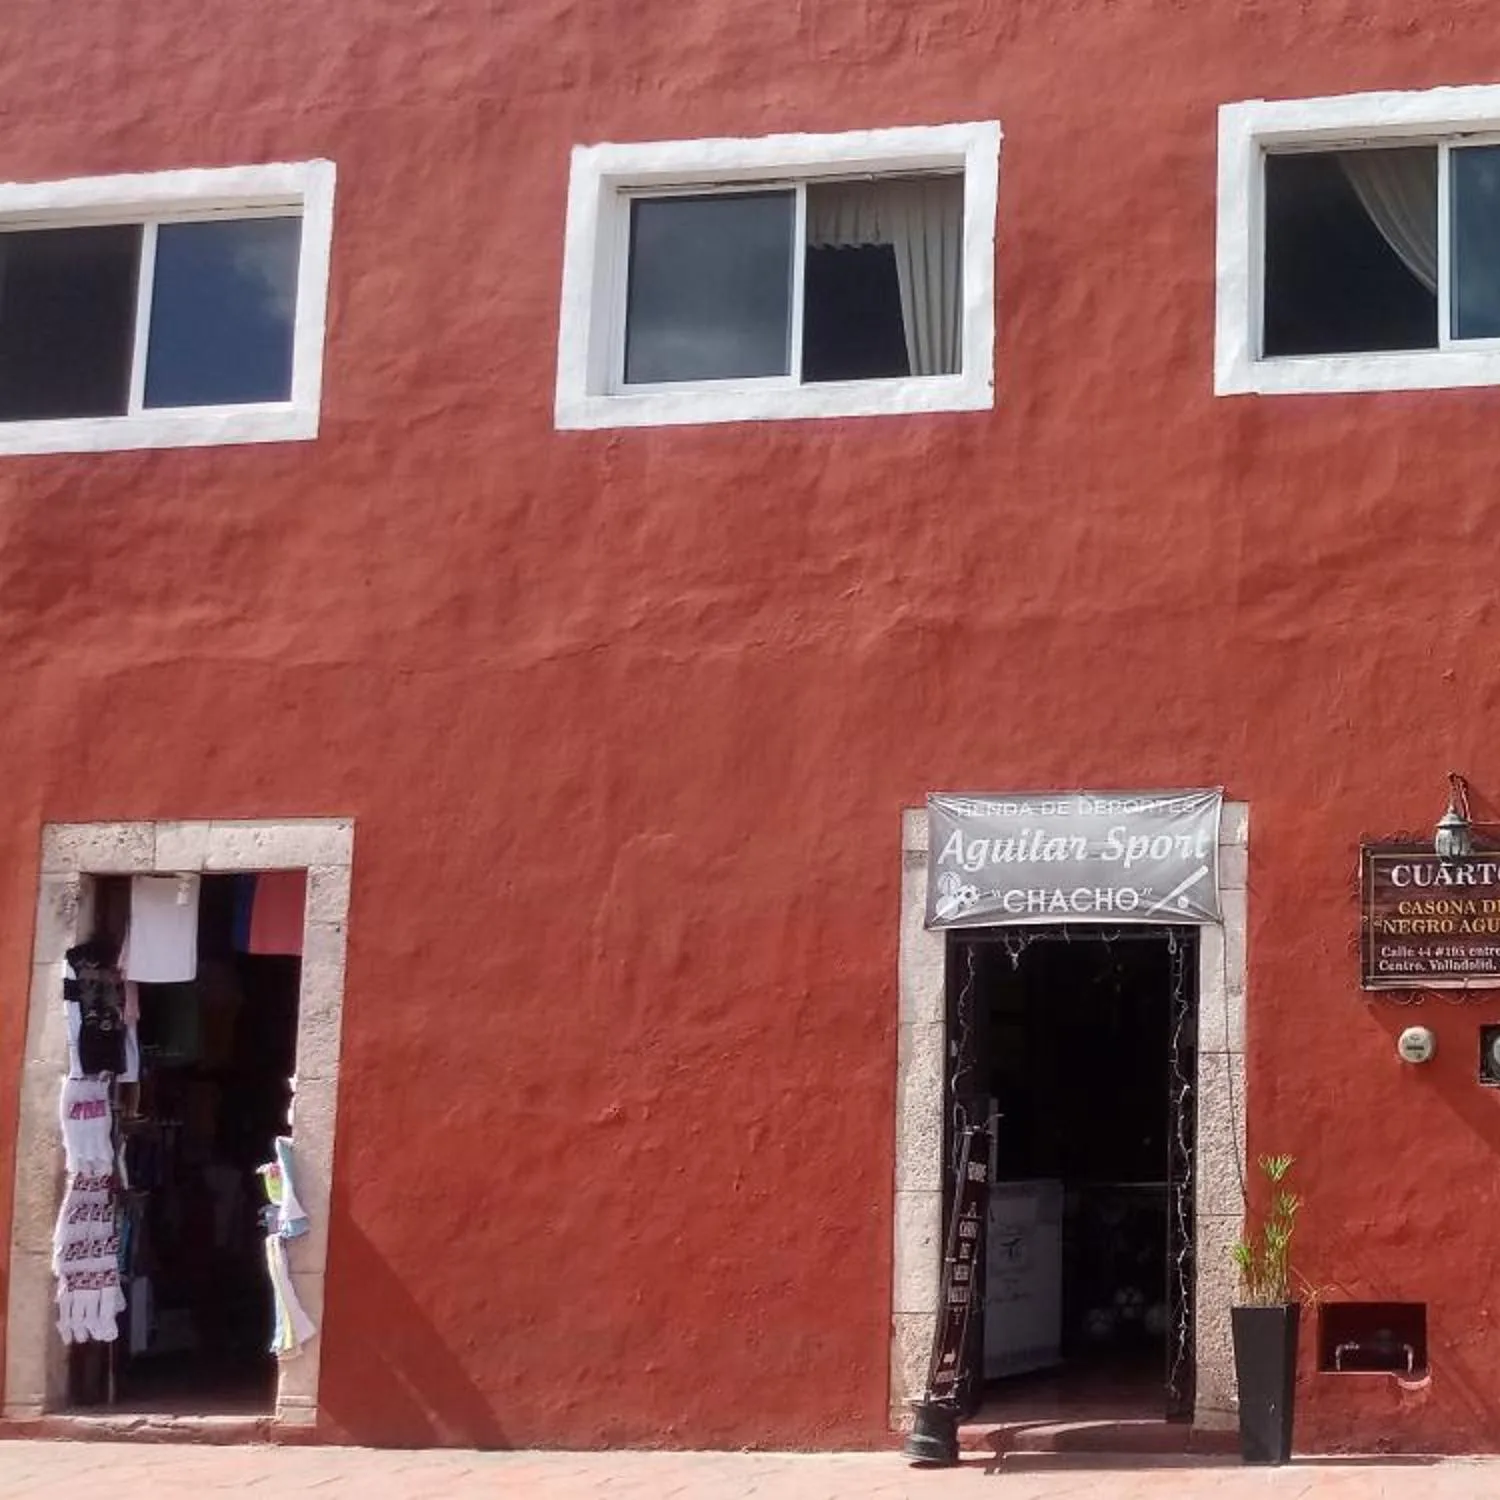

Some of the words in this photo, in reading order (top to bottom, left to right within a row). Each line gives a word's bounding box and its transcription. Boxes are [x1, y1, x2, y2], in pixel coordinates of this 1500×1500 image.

[1041, 801, 1072, 816] DE
[938, 828, 1088, 872] Aguilar
[1101, 826, 1210, 868] Sport
[1399, 900, 1477, 915] CASONA
[1383, 919, 1453, 935] NEGRO
[1381, 945, 1415, 957] Calle
